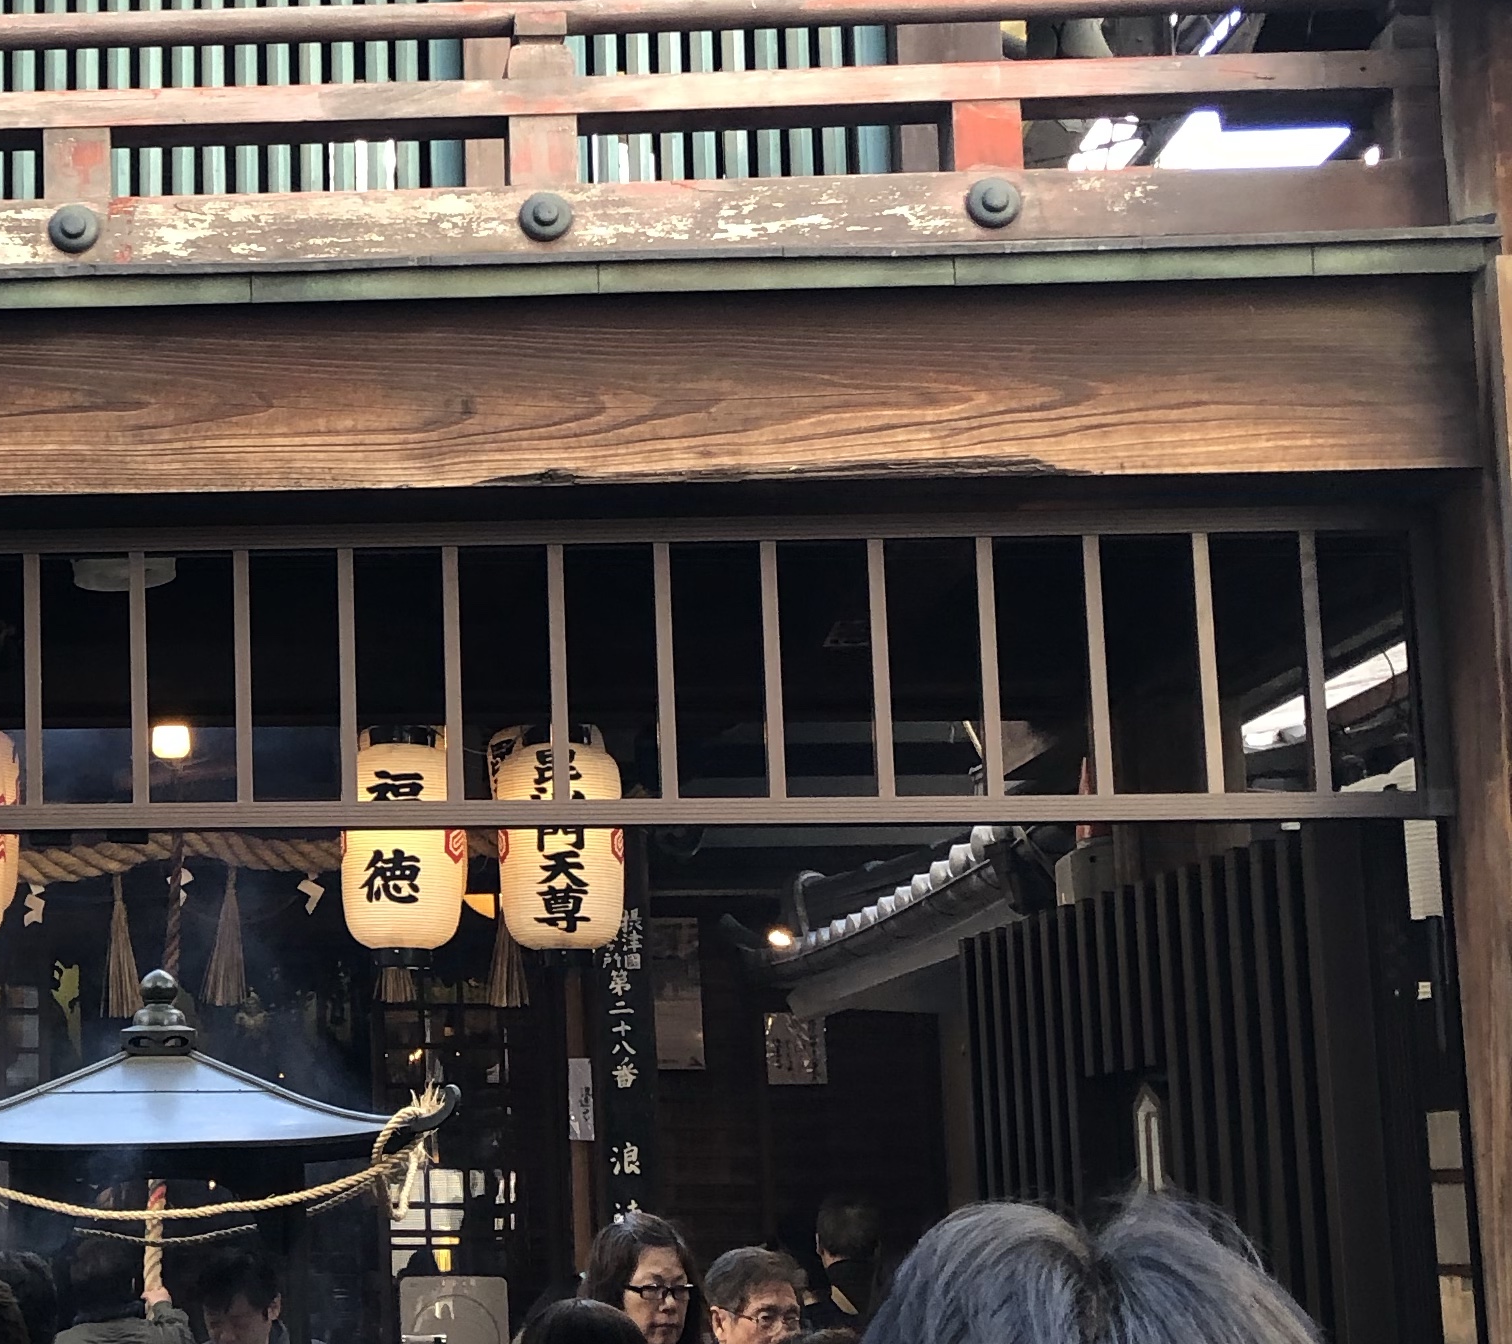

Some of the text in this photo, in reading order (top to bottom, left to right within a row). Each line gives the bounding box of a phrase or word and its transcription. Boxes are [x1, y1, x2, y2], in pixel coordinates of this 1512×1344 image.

[608, 970, 638, 1088] 第二十八番
